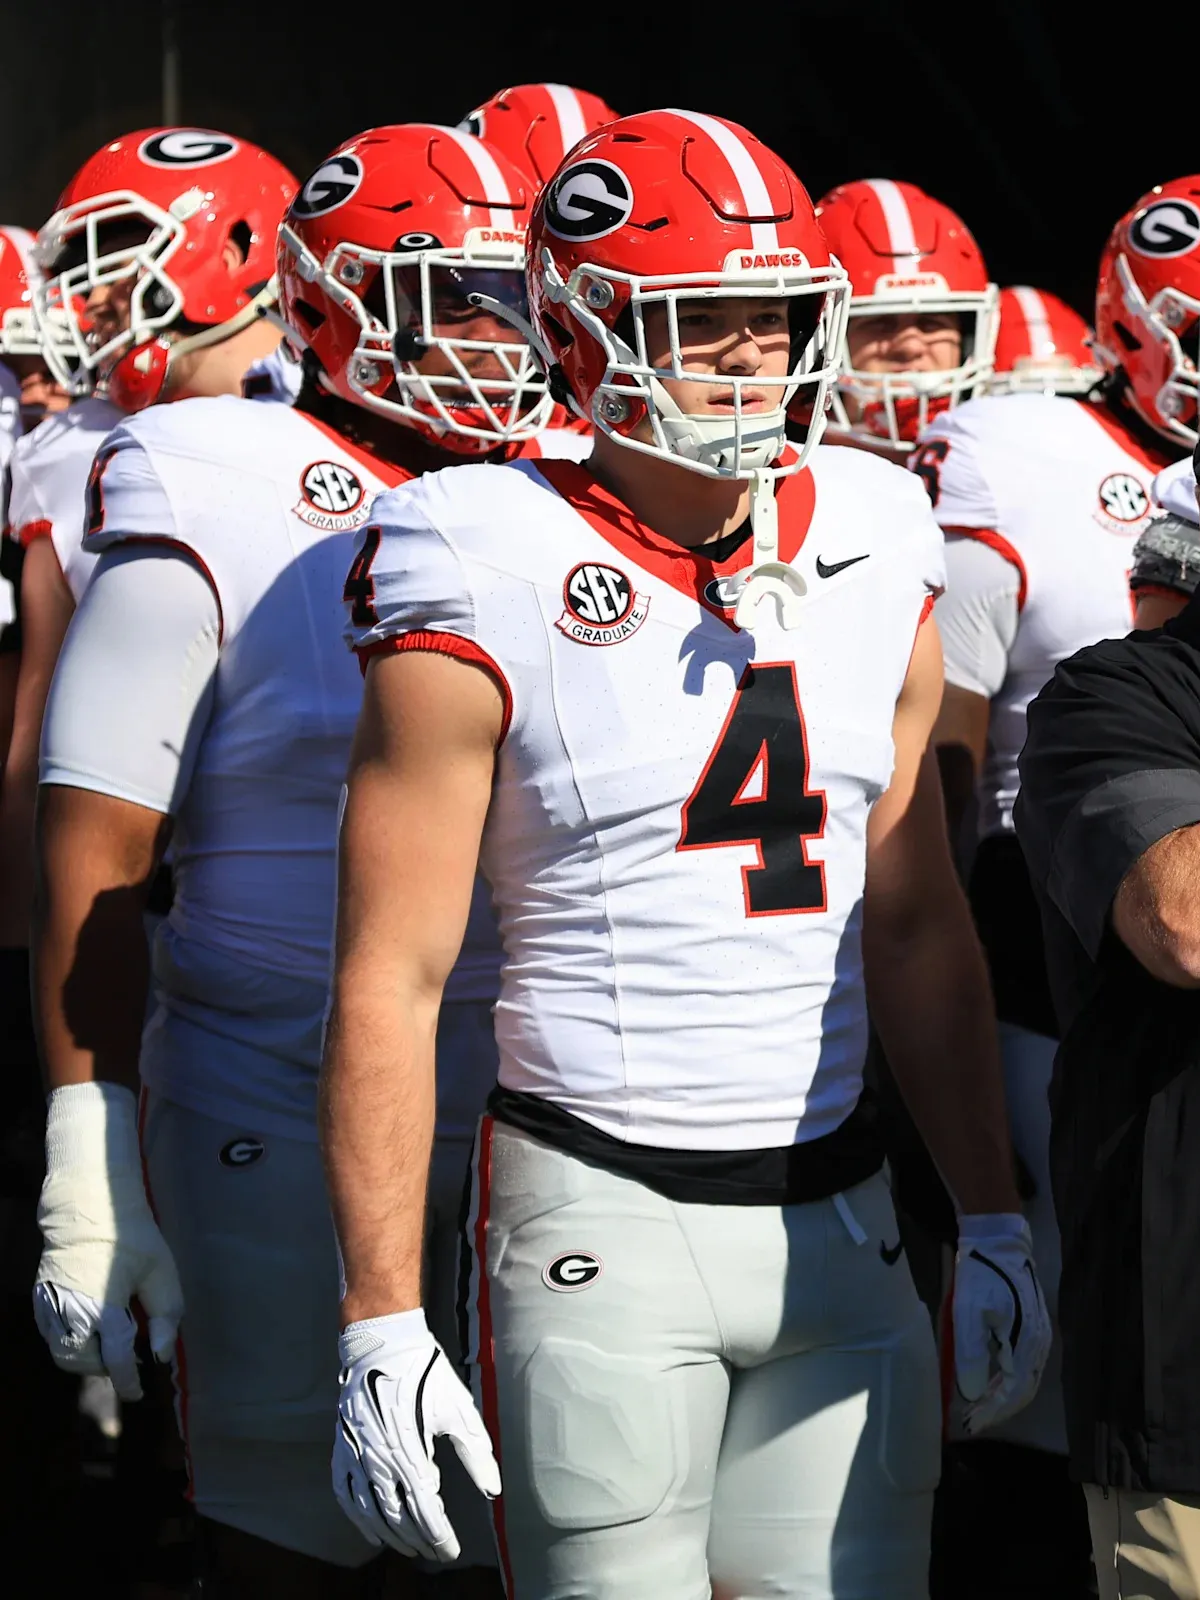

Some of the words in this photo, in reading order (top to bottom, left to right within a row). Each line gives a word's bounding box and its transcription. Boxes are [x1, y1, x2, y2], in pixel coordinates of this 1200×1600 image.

[142, 131, 234, 164] G
[293, 156, 361, 215] G
[545, 162, 629, 237] G
[480, 230, 525, 246] DAWG
[1131, 202, 1200, 254] G
[740, 253, 802, 269] DAWGS
[304, 462, 361, 513] SEC
[307, 503, 370, 531] GRADUATE
[342, 525, 383, 628] 4
[569, 565, 629, 623] SEC
[572, 611, 644, 643] GRADUATE
[676, 661, 828, 918] 4
[218, 1138, 265, 1168] G
[549, 1253, 600, 1287] G
